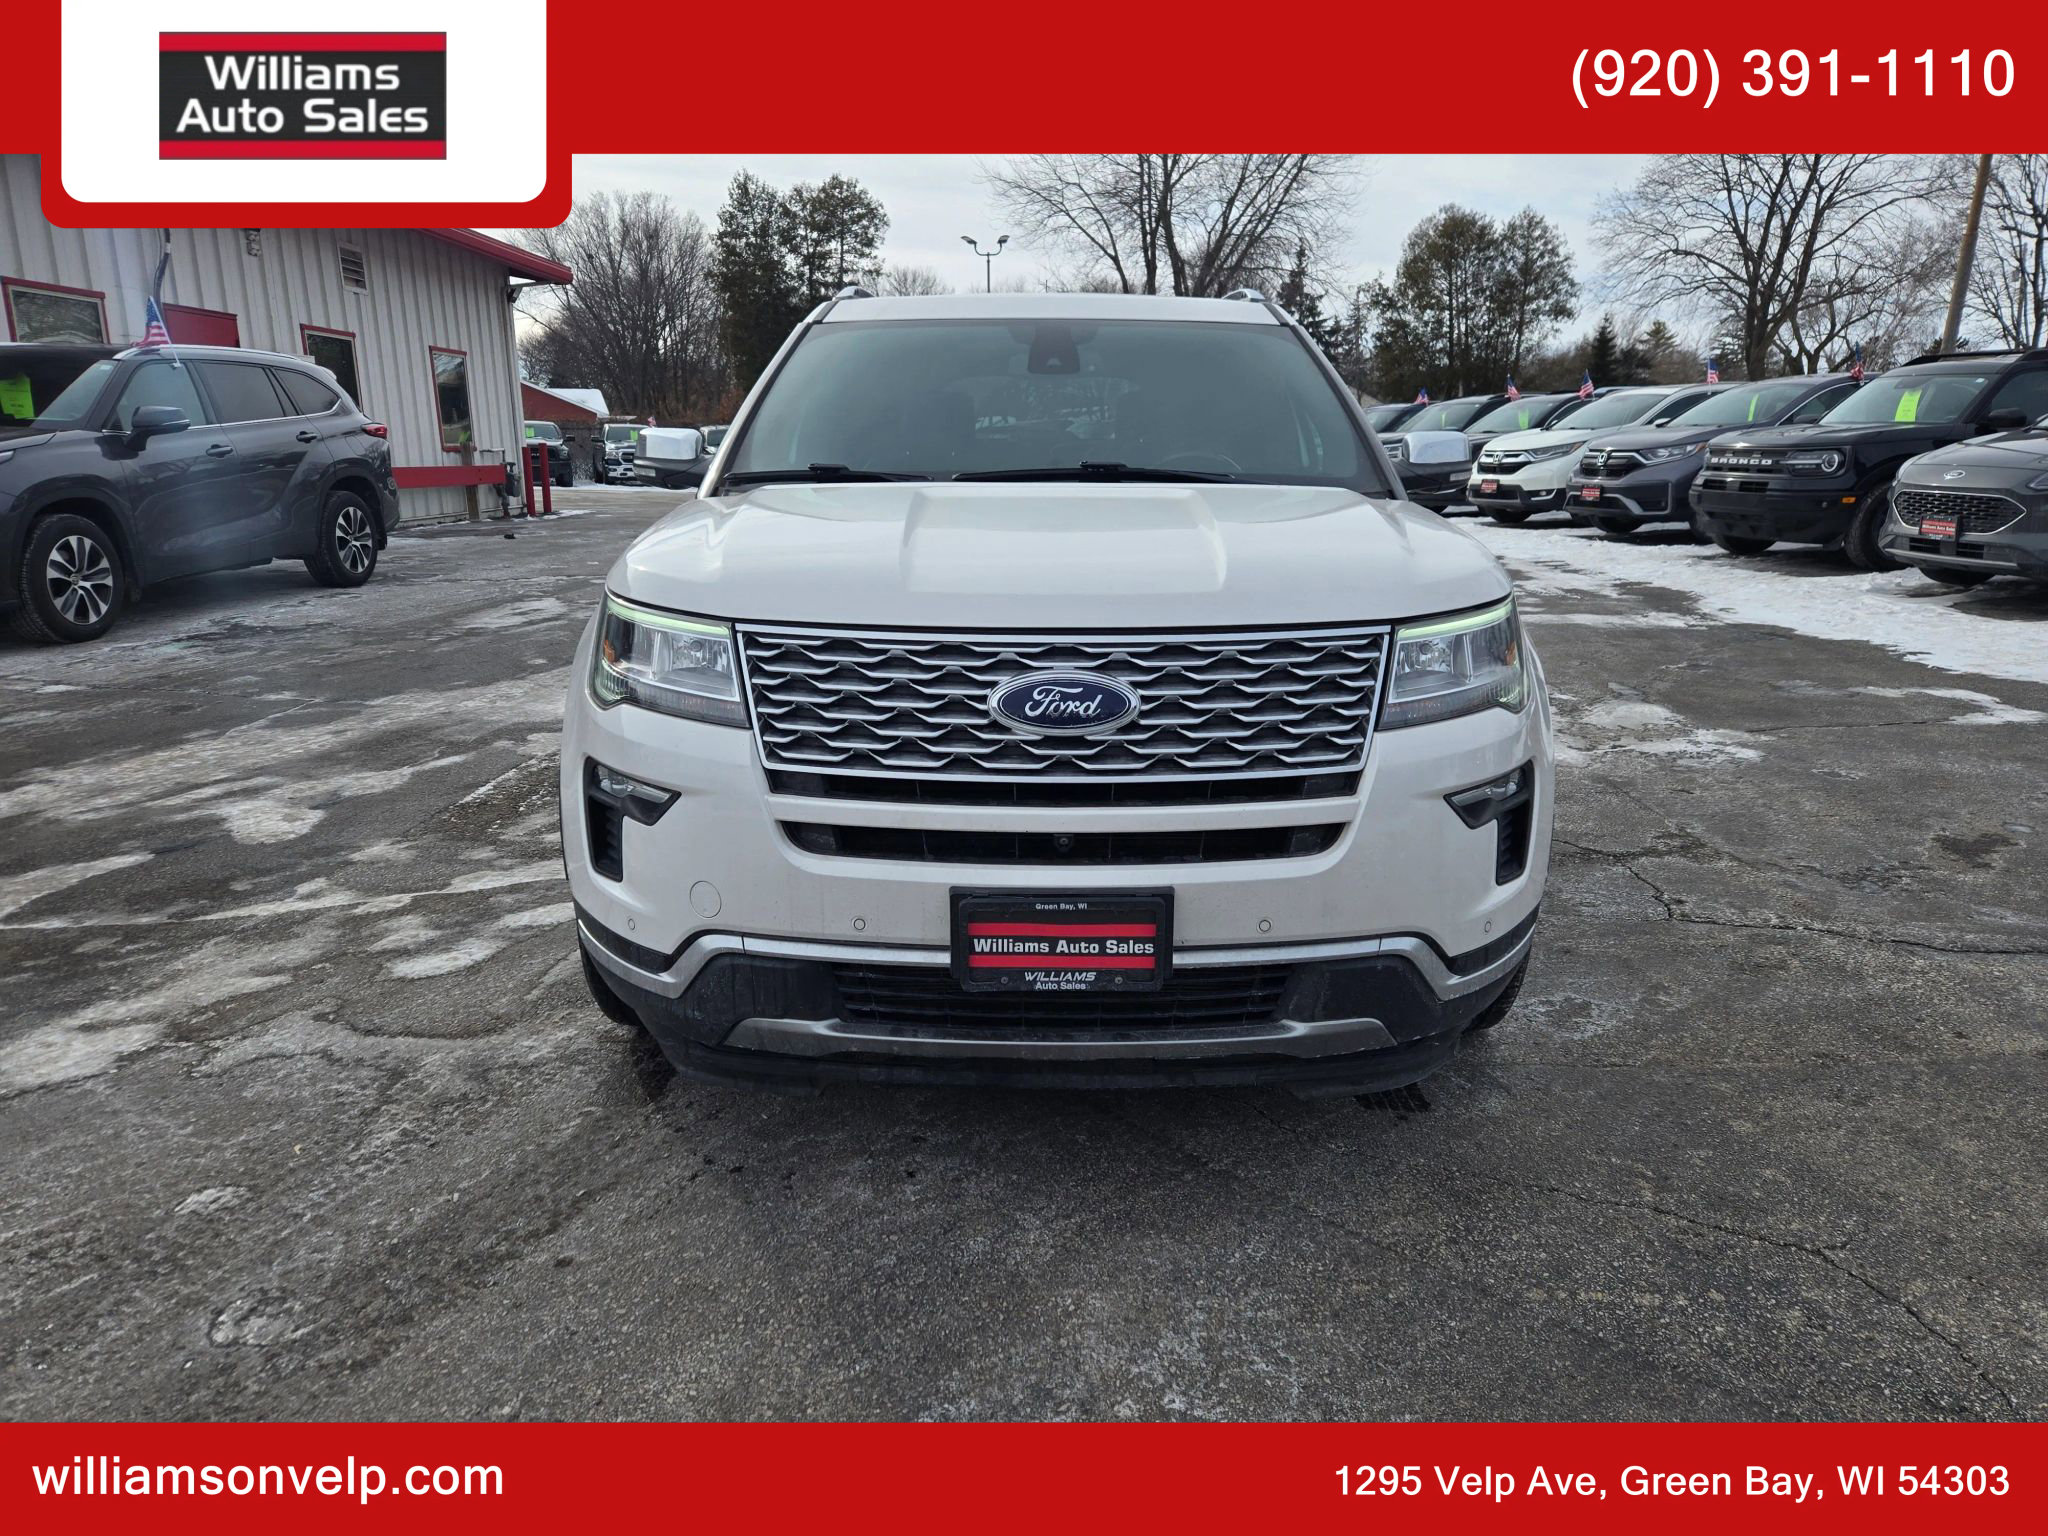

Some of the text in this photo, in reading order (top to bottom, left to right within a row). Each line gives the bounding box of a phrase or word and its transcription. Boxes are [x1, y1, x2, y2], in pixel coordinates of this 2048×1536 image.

[1710, 457, 1773, 466] BRONCO
[1024, 685, 1103, 718] Ford
[1034, 902, 1088, 911] Green Bay, WI
[973, 938, 1155, 955] Williams Auto Sales
[1024, 971, 1097, 982] WILLIAMS
[1035, 981, 1087, 991] Auto Sales
